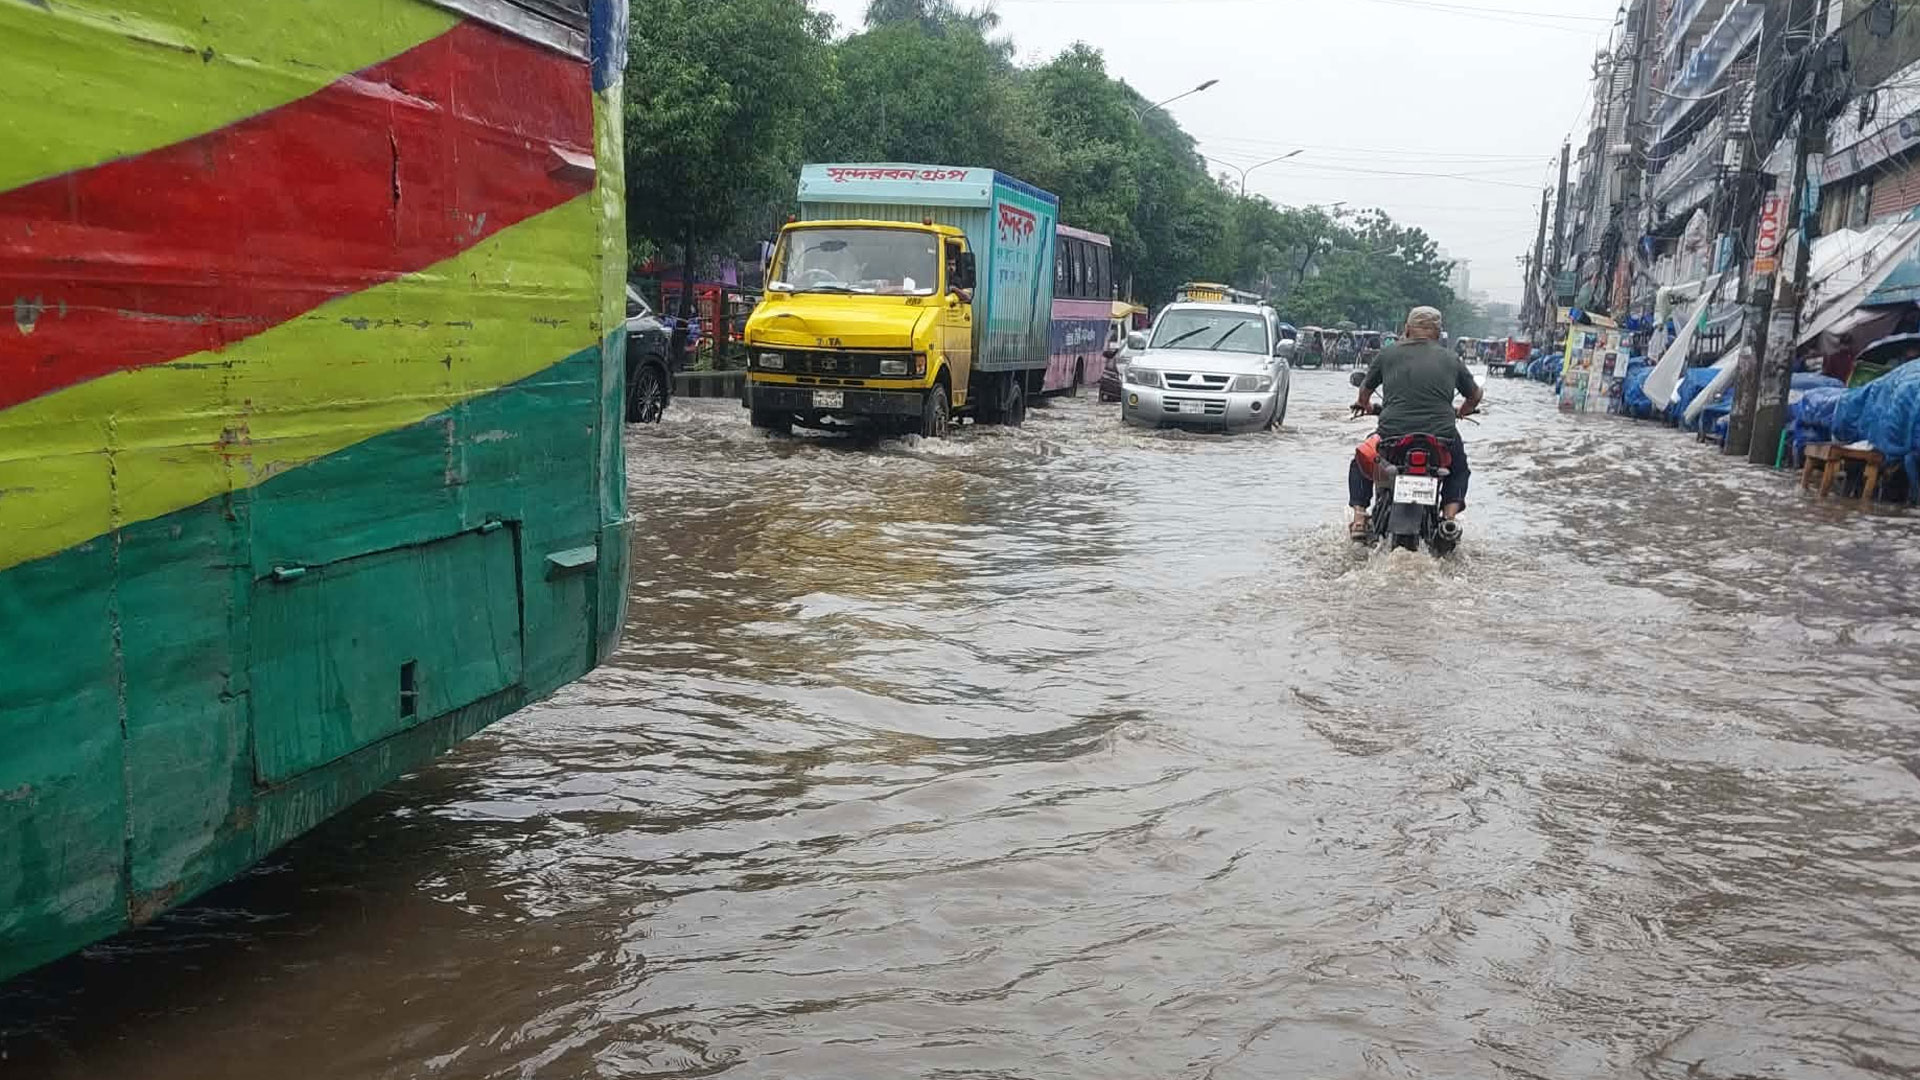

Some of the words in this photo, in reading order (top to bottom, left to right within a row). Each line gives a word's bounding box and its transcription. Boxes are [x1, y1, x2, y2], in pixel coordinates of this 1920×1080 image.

[827, 168, 915, 182] সুন্দরবন
[920, 169, 968, 181] গ্রুপ
[816, 337, 842, 346] TTA
